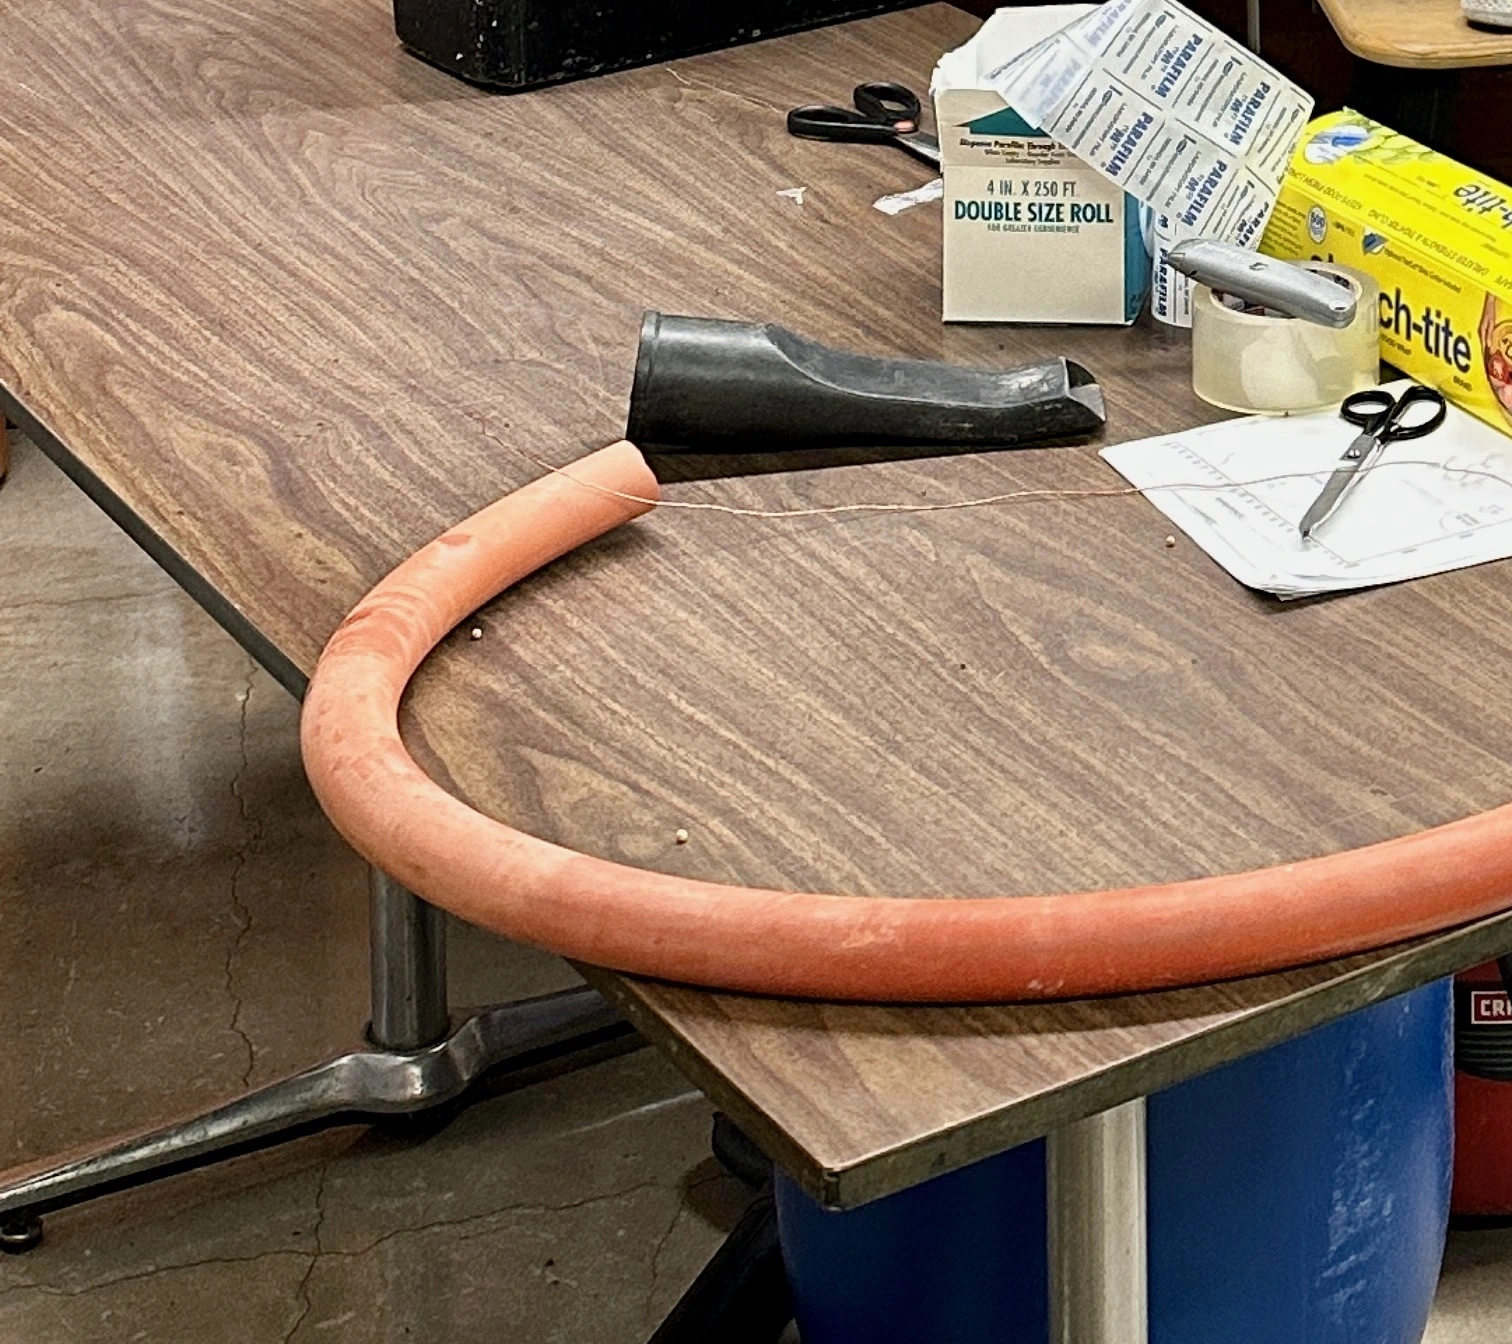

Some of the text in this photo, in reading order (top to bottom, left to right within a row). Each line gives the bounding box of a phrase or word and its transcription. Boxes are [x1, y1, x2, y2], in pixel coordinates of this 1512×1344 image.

[1155, 33, 1203, 98] PARAFILM
[1105, 112, 1154, 176] PARAFILM
[1229, 81, 1270, 145] PARAFILM
[954, 200, 1114, 223] DOUBLE SIZE ROLL
[986, 180, 995, 195] 4
[1021, 180, 1030, 195] X
[1035, 181, 1058, 197] 250
[1181, 159, 1228, 227] PARAFILM
[1238, 201, 1270, 248] PARAF
[1158, 247, 1169, 317] PARAFILM
